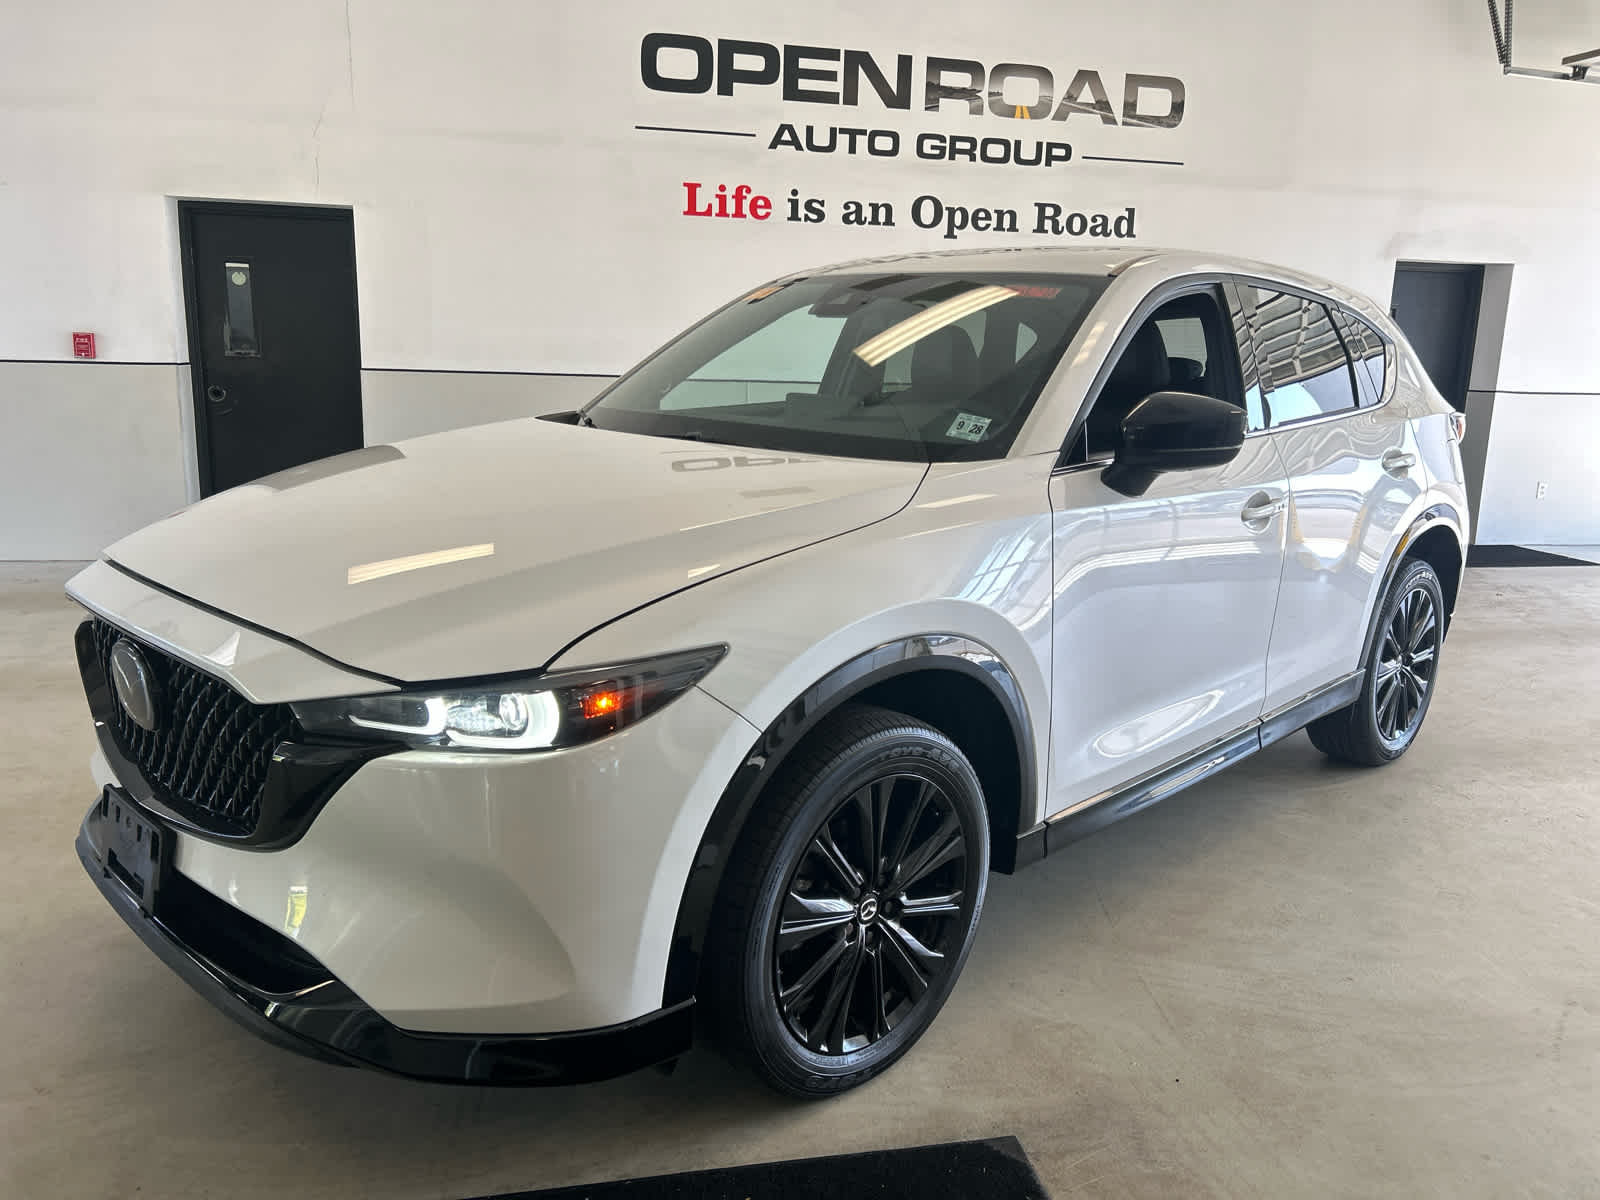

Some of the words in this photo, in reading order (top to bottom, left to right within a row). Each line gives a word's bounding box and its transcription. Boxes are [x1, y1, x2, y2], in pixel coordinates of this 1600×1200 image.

[641, 33, 912, 110] OPEN
[924, 56, 1186, 129] ROAD
[768, 124, 900, 157] AUTO
[916, 133, 1073, 168] GROUP
[683, 182, 773, 220] Life
[787, 189, 826, 224] is
[841, 201, 896, 227] an
[911, 196, 1020, 240] Open
[1032, 203, 1137, 239] Road
[956, 420, 965, 430] 9
